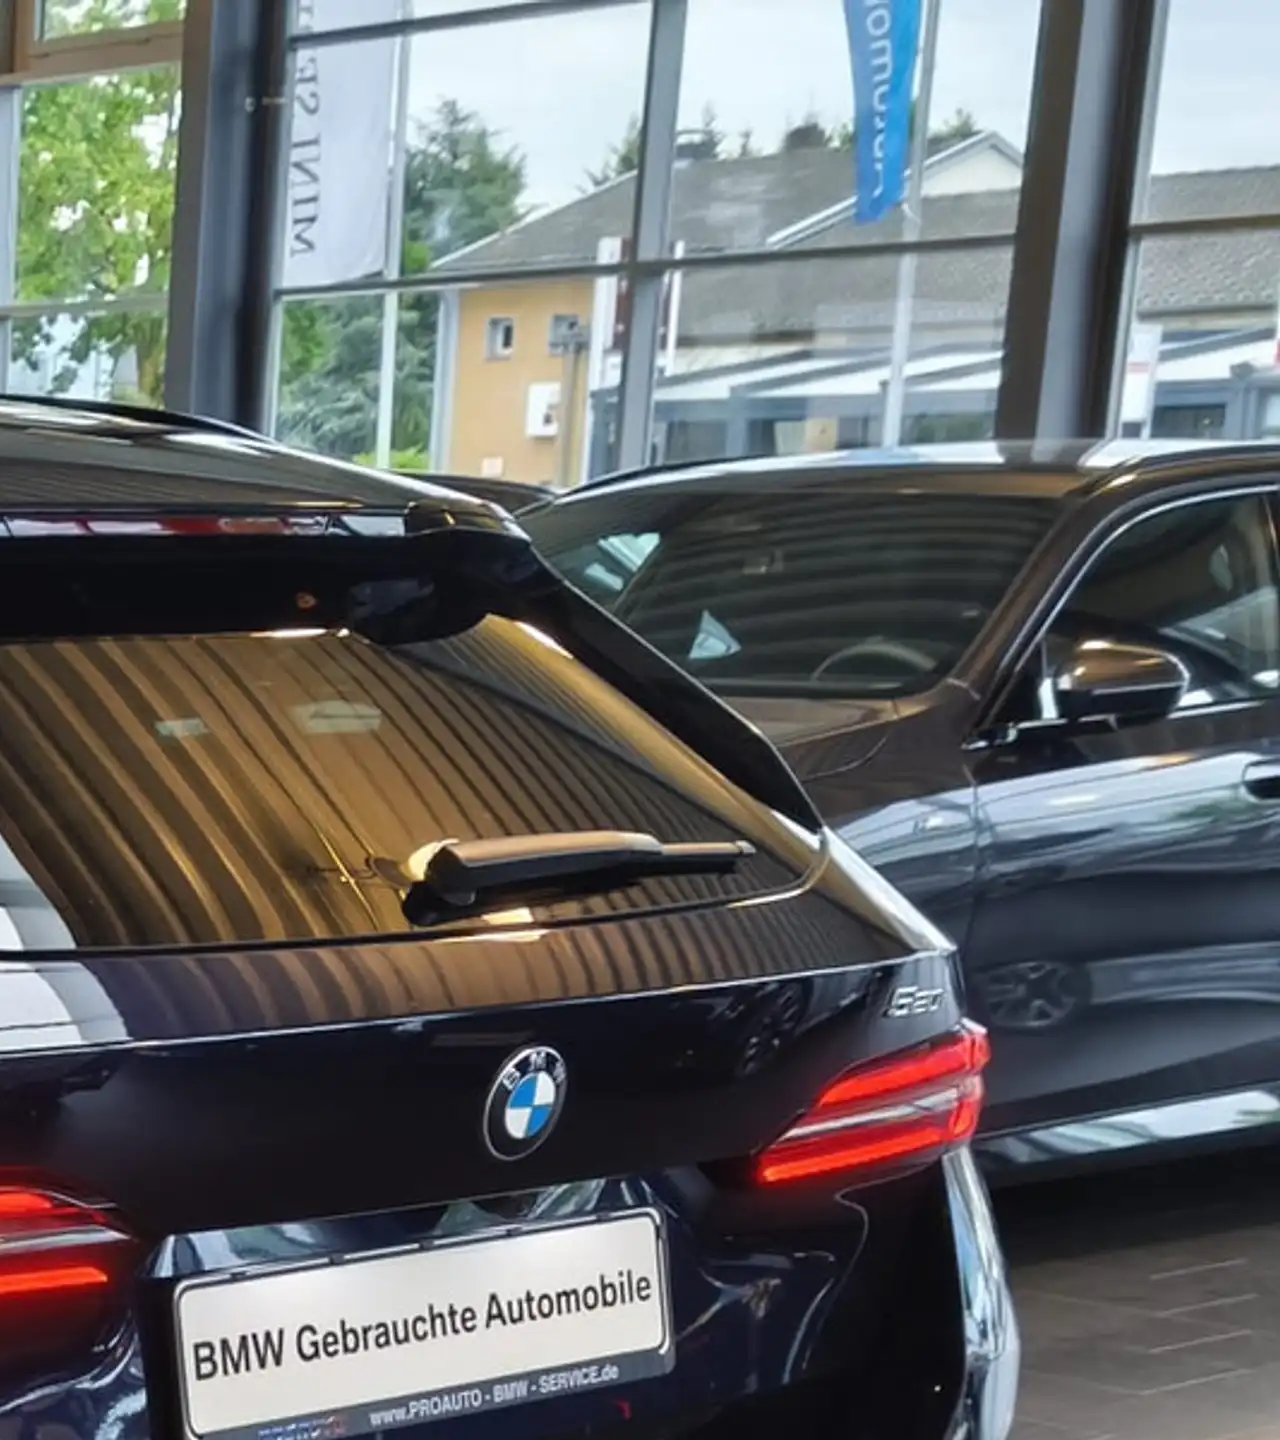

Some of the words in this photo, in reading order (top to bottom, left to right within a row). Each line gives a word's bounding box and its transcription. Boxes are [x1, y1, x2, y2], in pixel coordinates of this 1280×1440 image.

[193, 1327, 284, 1381] BMW
[296, 1302, 477, 1362] Gebrauchte
[485, 1268, 652, 1329] Automobile
[369, 1389, 482, 1426] www.PROAUTO
[493, 1379, 530, 1403] BMW
[539, 1363, 619, 1394] SERVICE.de
